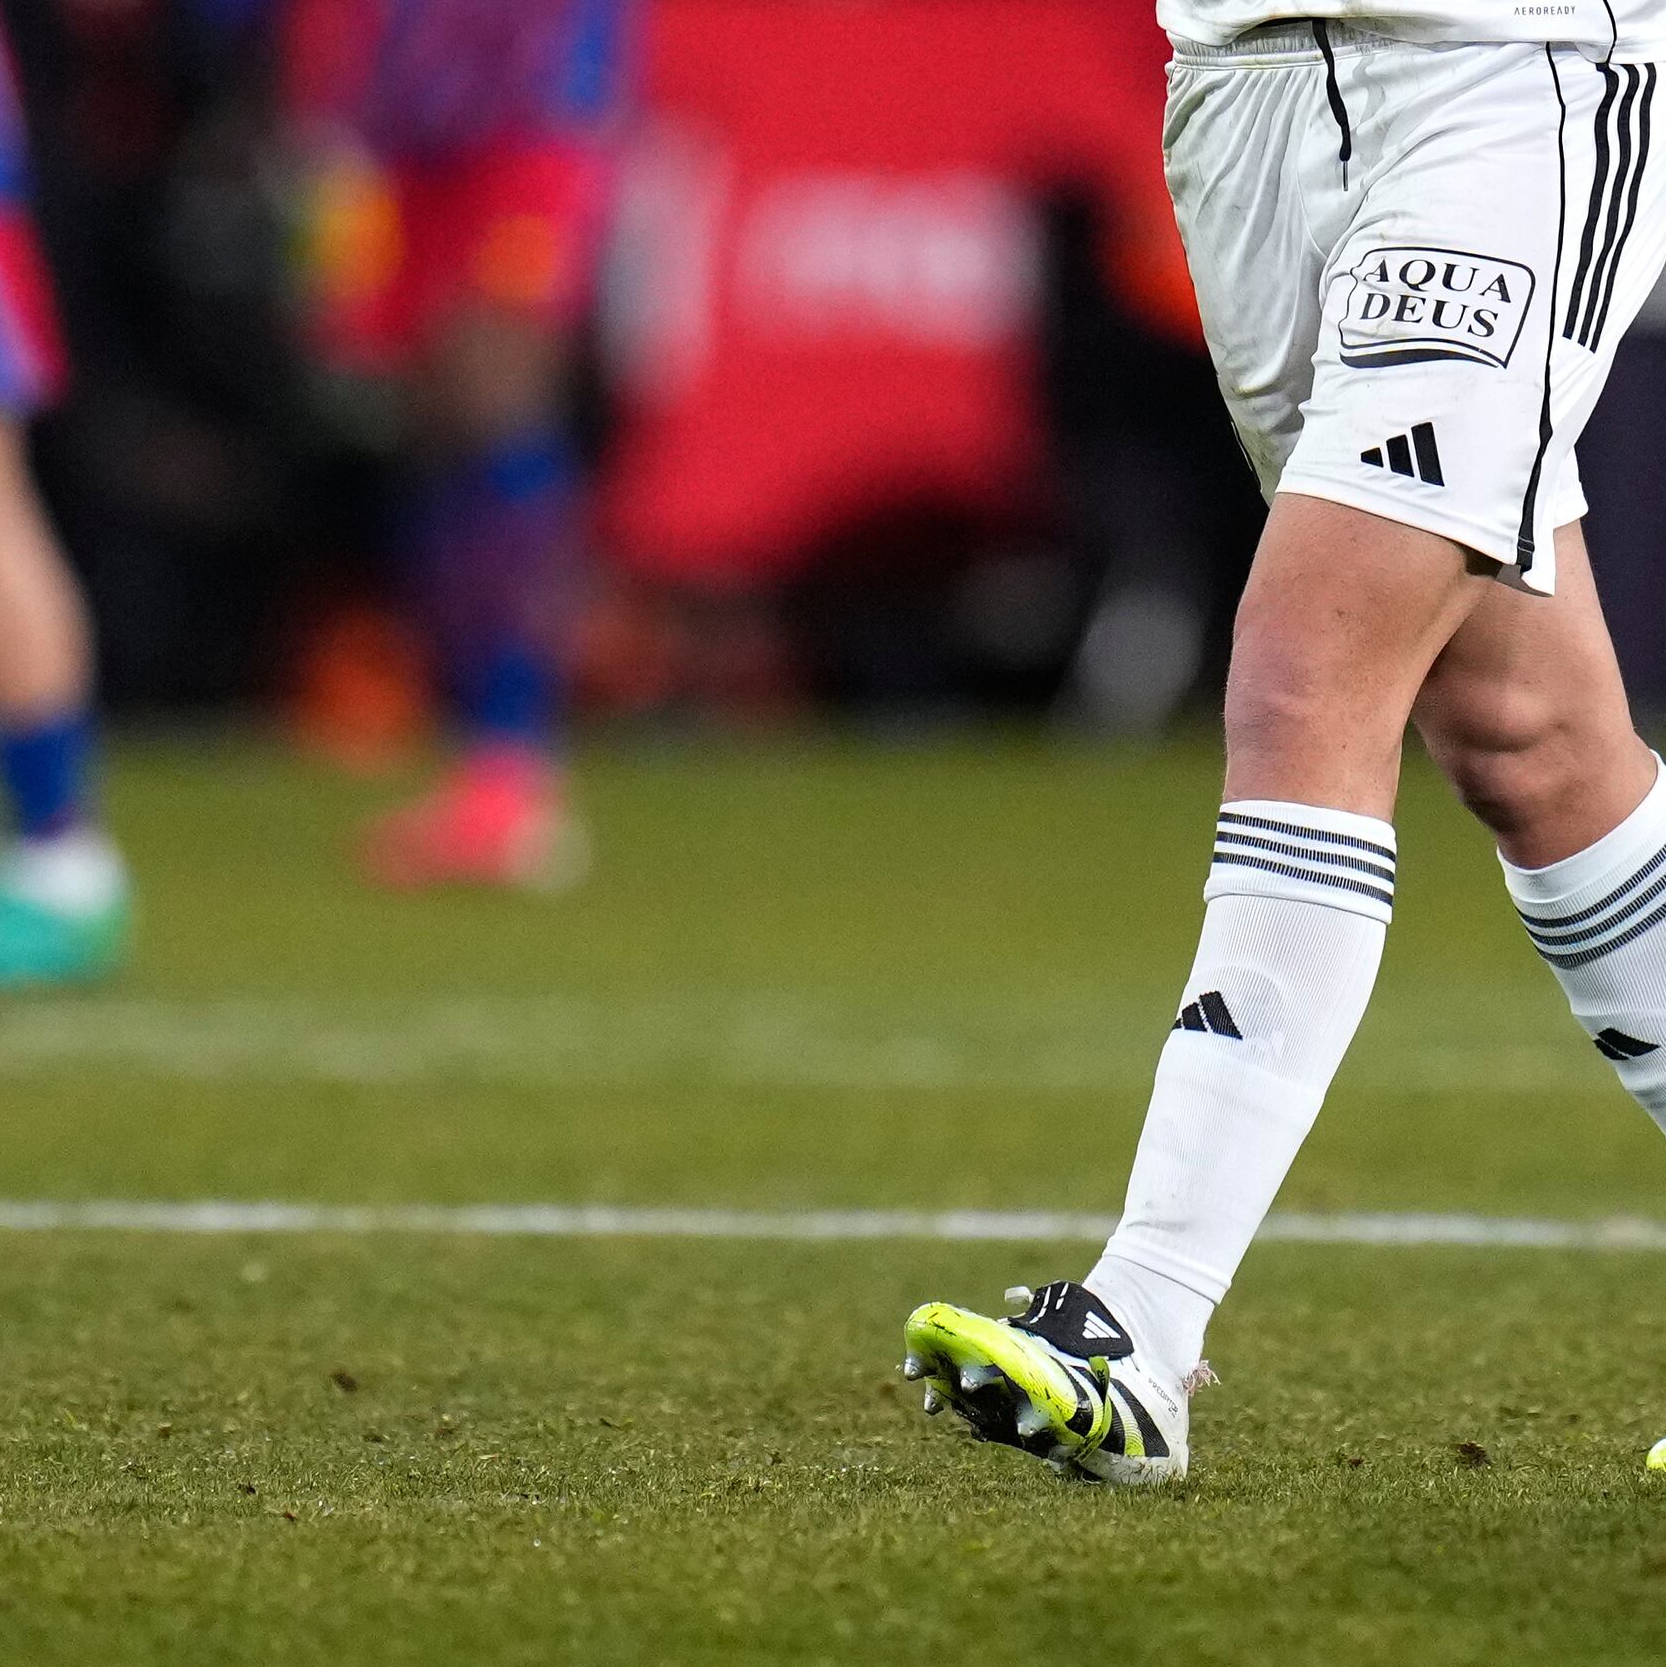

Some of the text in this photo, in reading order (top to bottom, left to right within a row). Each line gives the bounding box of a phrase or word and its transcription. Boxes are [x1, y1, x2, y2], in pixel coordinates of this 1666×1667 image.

[1514, 6, 1576, 16] AEROREADY
[1363, 258, 1512, 304] AQUA
[1359, 292, 1499, 338] DEUS
